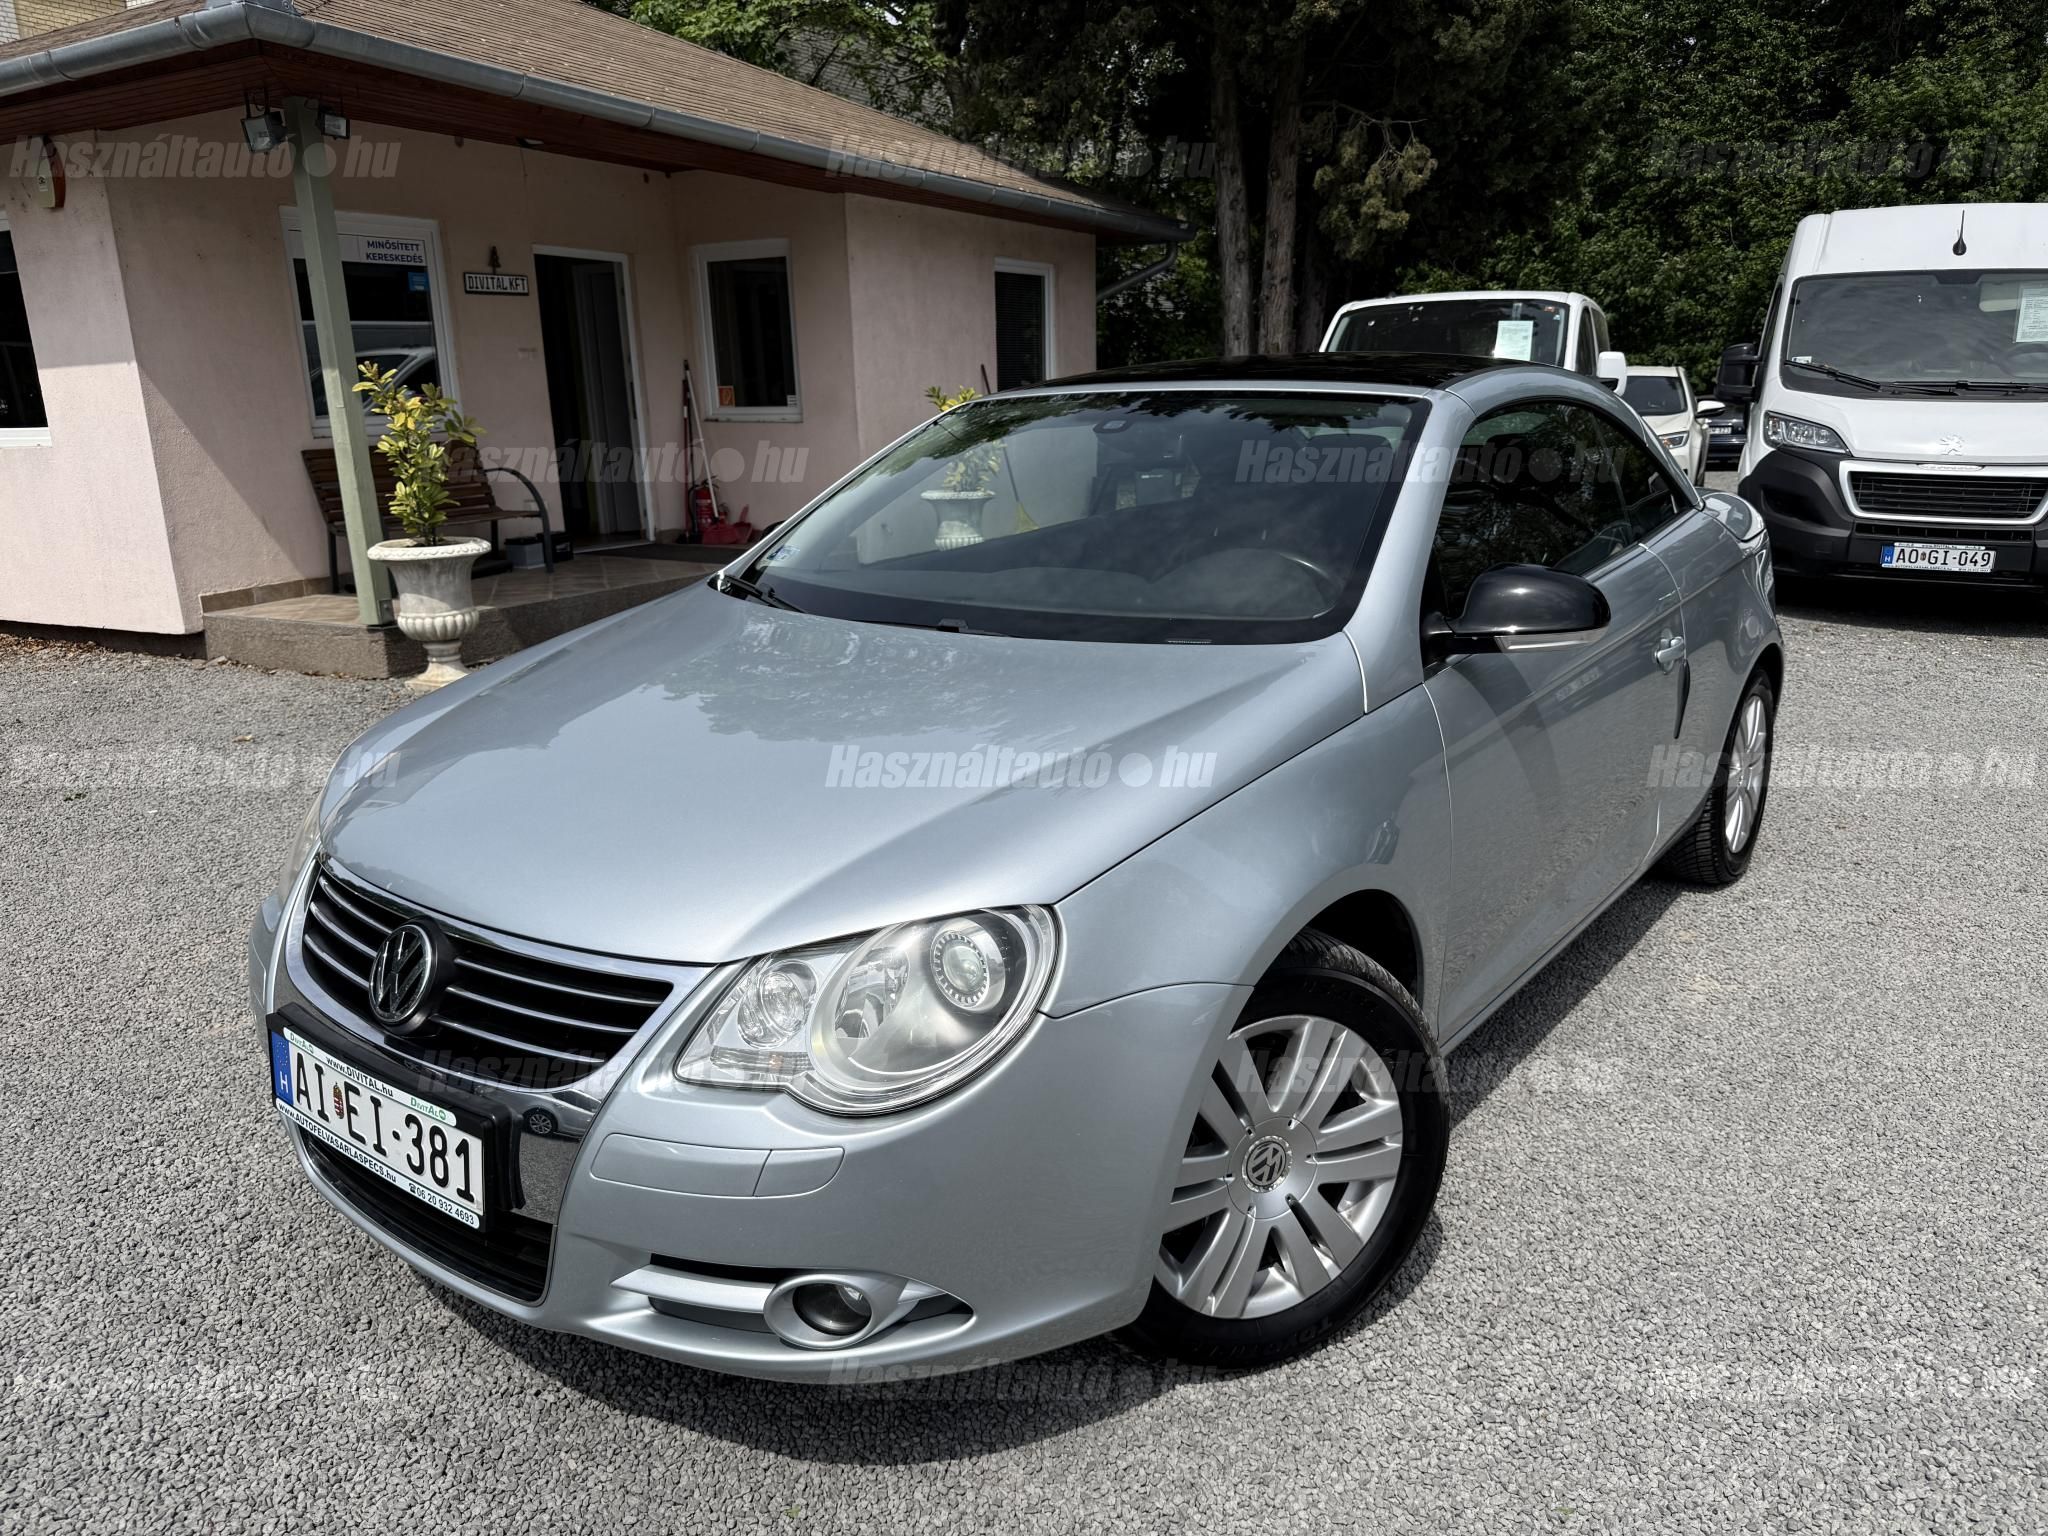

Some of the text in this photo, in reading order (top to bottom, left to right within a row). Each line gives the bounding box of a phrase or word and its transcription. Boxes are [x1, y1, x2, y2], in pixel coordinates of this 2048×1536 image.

[367, 240, 420, 251] MINŐSÍTETT
[366, 252, 424, 263] KERESKEDÉS
[468, 276, 527, 291] DIVITAL KFT
[280, 1070, 289, 1094] H
[326, 1056, 394, 1097] www.DIVITAL.hu
[416, 1187, 474, 1225] 06 20 932 4693
